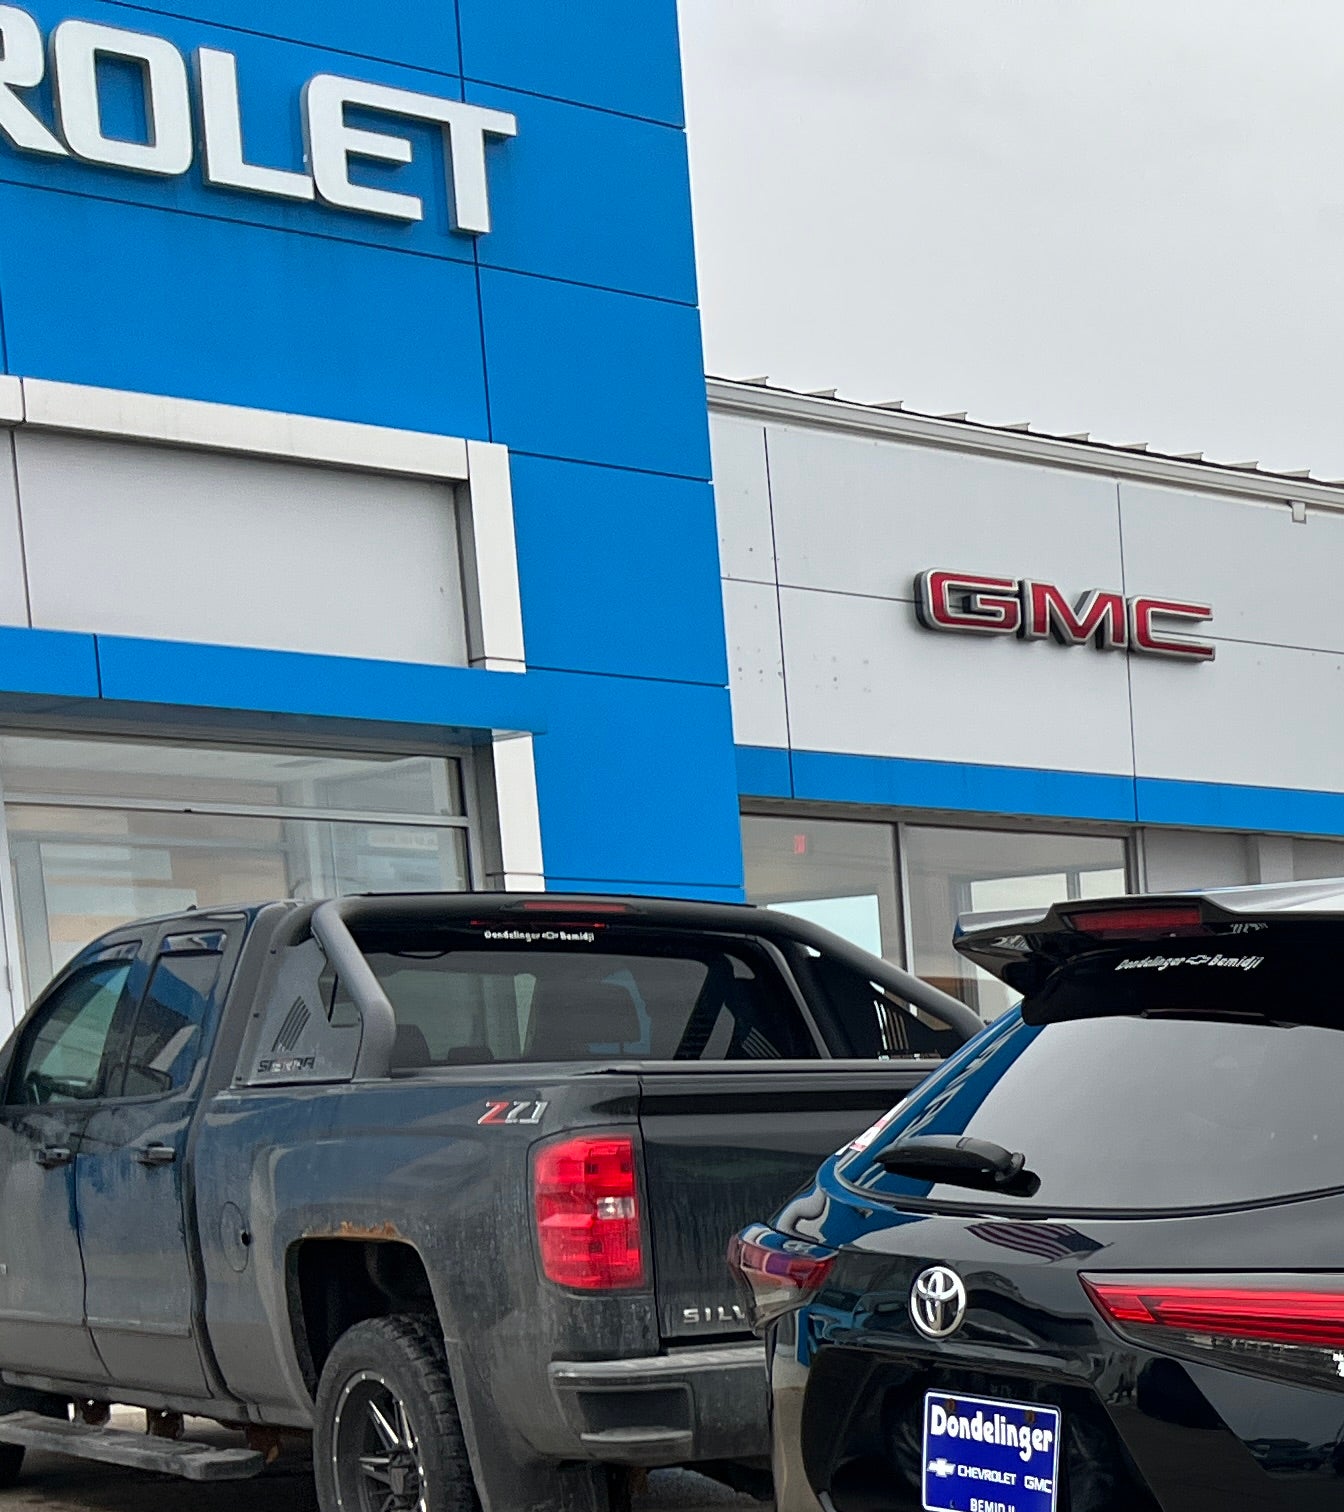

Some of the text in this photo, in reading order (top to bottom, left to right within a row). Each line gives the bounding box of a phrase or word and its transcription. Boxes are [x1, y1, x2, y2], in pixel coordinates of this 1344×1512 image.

[913, 567, 1215, 661] GMC
[1208, 954, 1265, 971] Bemidji
[477, 1100, 549, 1125] Z71
[930, 1404, 1053, 1463] Dondelinger
[957, 1464, 1053, 1494] CHEVROLET GMC
